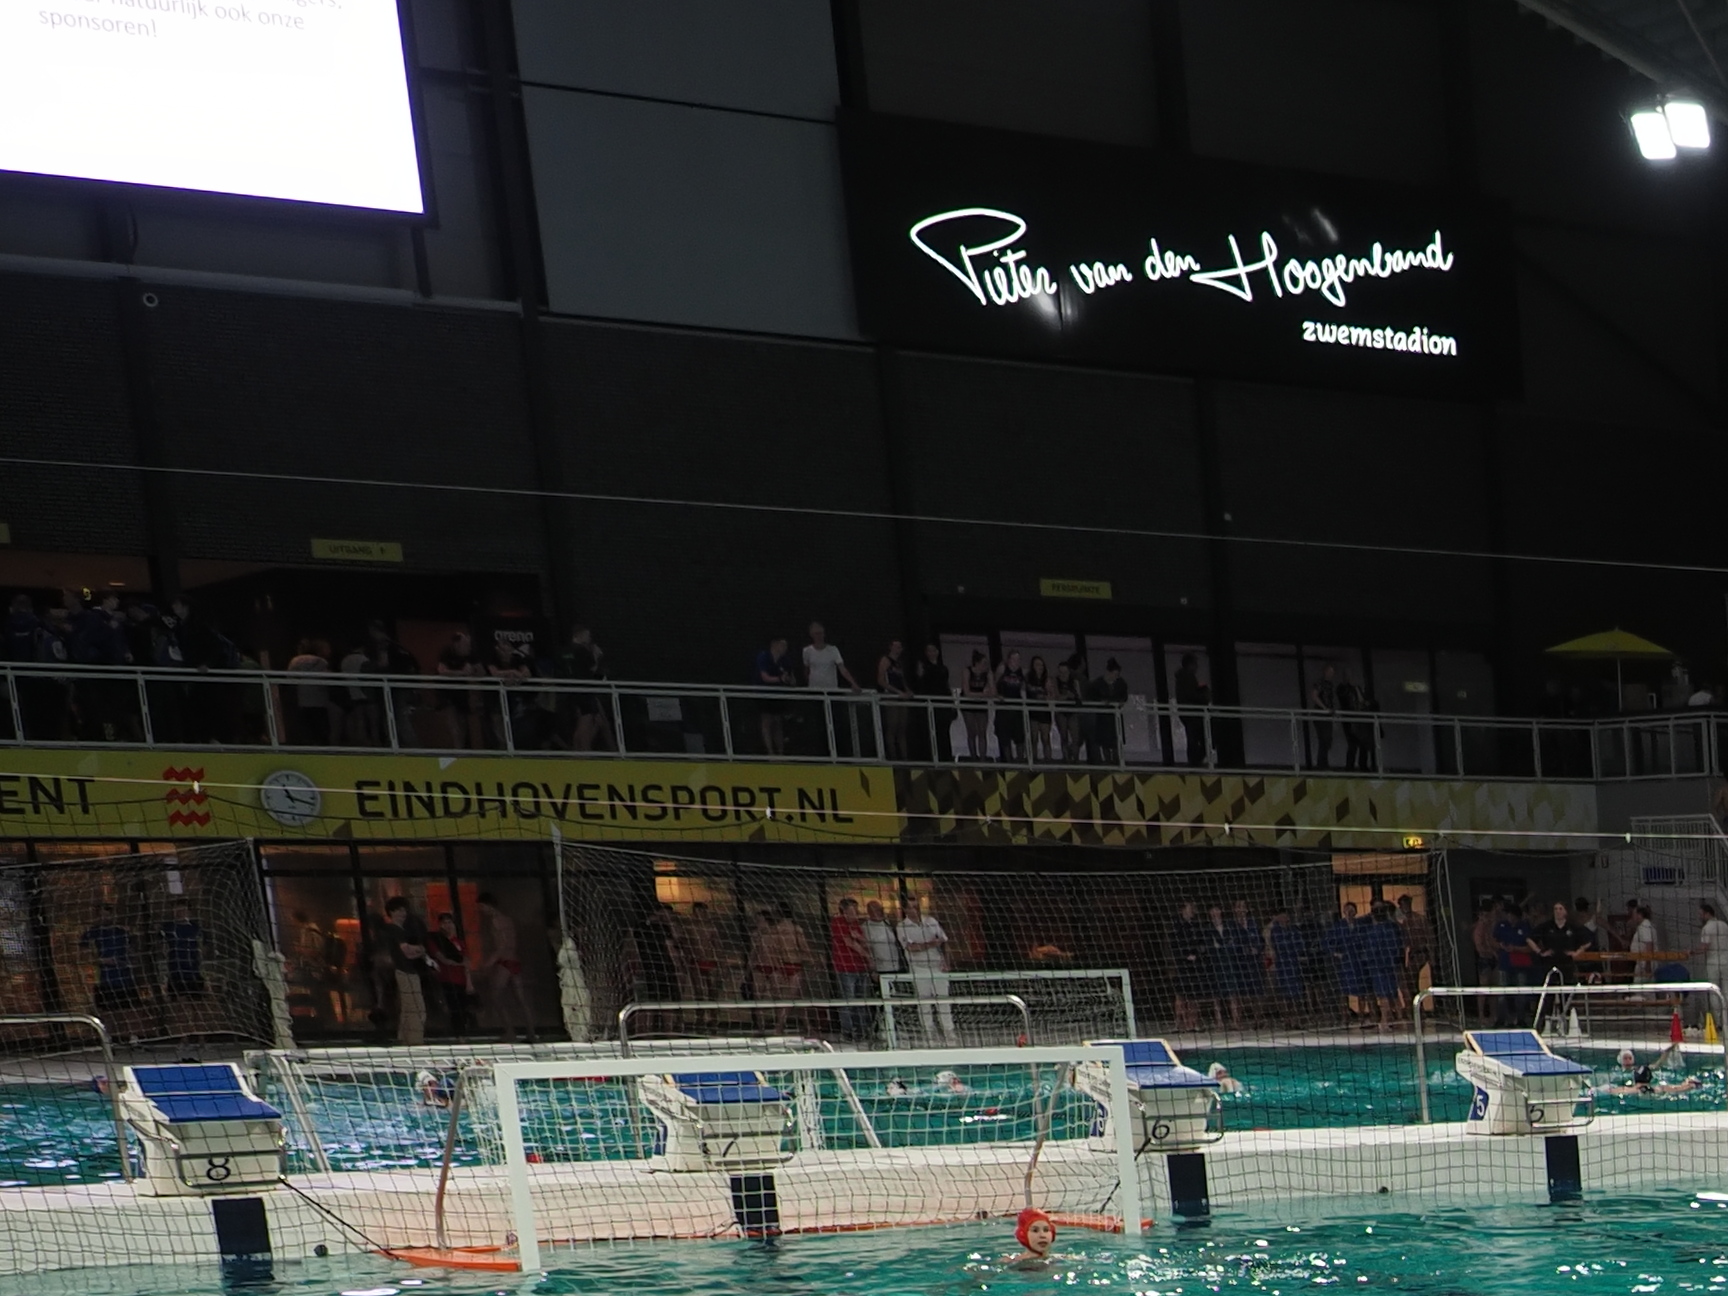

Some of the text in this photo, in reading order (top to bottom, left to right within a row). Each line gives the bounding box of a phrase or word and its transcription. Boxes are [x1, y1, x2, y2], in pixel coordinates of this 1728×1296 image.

[38, 10, 158, 38] sponsoren!
[214, 3, 253, 23] ook
[258, 11, 305, 30] onze
[910, 208, 1454, 307] Pieter van den Hoogenband
[1302, 319, 1458, 357] zwemstadion
[494, 630, 534, 643] arena
[356, 780, 855, 825] EINDHOVENSPORT.NL
[1476, 1095, 1484, 1117] 5
[1151, 1119, 1171, 1141] 6
[206, 1154, 231, 1182] 8
